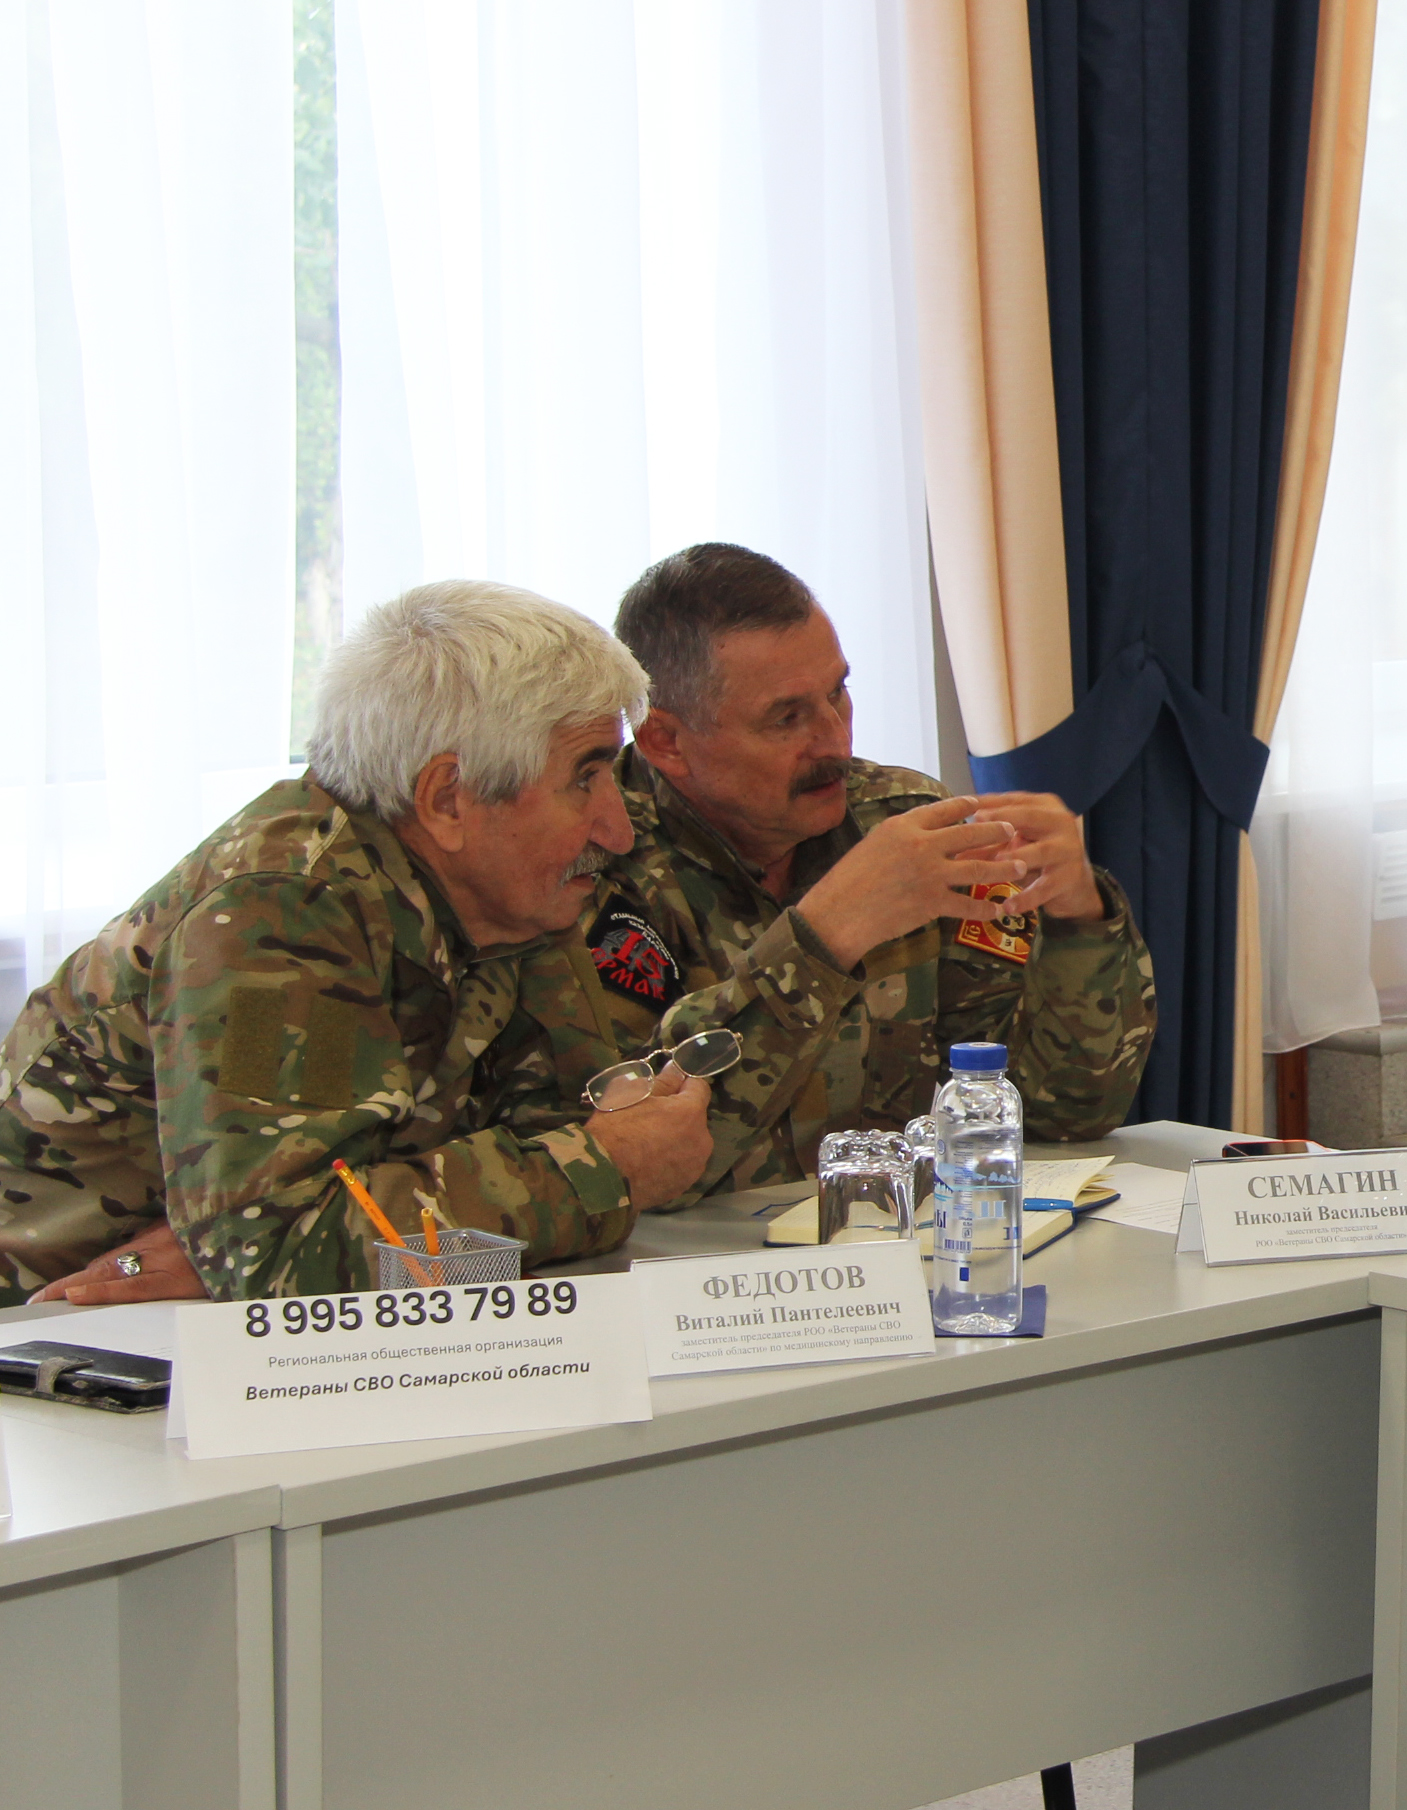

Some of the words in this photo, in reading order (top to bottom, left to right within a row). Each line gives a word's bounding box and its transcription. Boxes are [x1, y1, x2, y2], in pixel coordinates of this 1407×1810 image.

[610, 928, 669, 979] 15
[1248, 1170, 1399, 1198] СЕМАГИН
[1235, 1207, 1312, 1225] Николай
[703, 1266, 865, 1300] ФЕДОТОВ
[246, 1303, 271, 1337] 8
[283, 1297, 362, 1334] 995
[376, 1290, 453, 1327] 833
[464, 1286, 515, 1321] 79
[528, 1281, 577, 1316] 89
[676, 1308, 764, 1331] Виталий
[771, 1302, 900, 1323] Пантелеевич
[672, 1347, 723, 1362] Самарской
[726, 1345, 767, 1356] области»
[770, 1344, 781, 1353] по
[784, 1338, 851, 1351] медицинскому
[854, 1334, 913, 1347] направлению
[681, 1335, 738, 1348] заместитель
[740, 1329, 801, 1344] председателя
[804, 1325, 825, 1337] РОО
[828, 1323, 877, 1335] «Ветераны
[879, 1319, 901, 1331] СВО
[269, 1352, 367, 1368] Региональная
[371, 1344, 471, 1360] общественная
[475, 1337, 562, 1353] организация
[246, 1383, 348, 1400] Ветераны
[354, 1375, 393, 1391] СВО
[399, 1366, 502, 1387] Самарской
[508, 1363, 589, 1378] области
